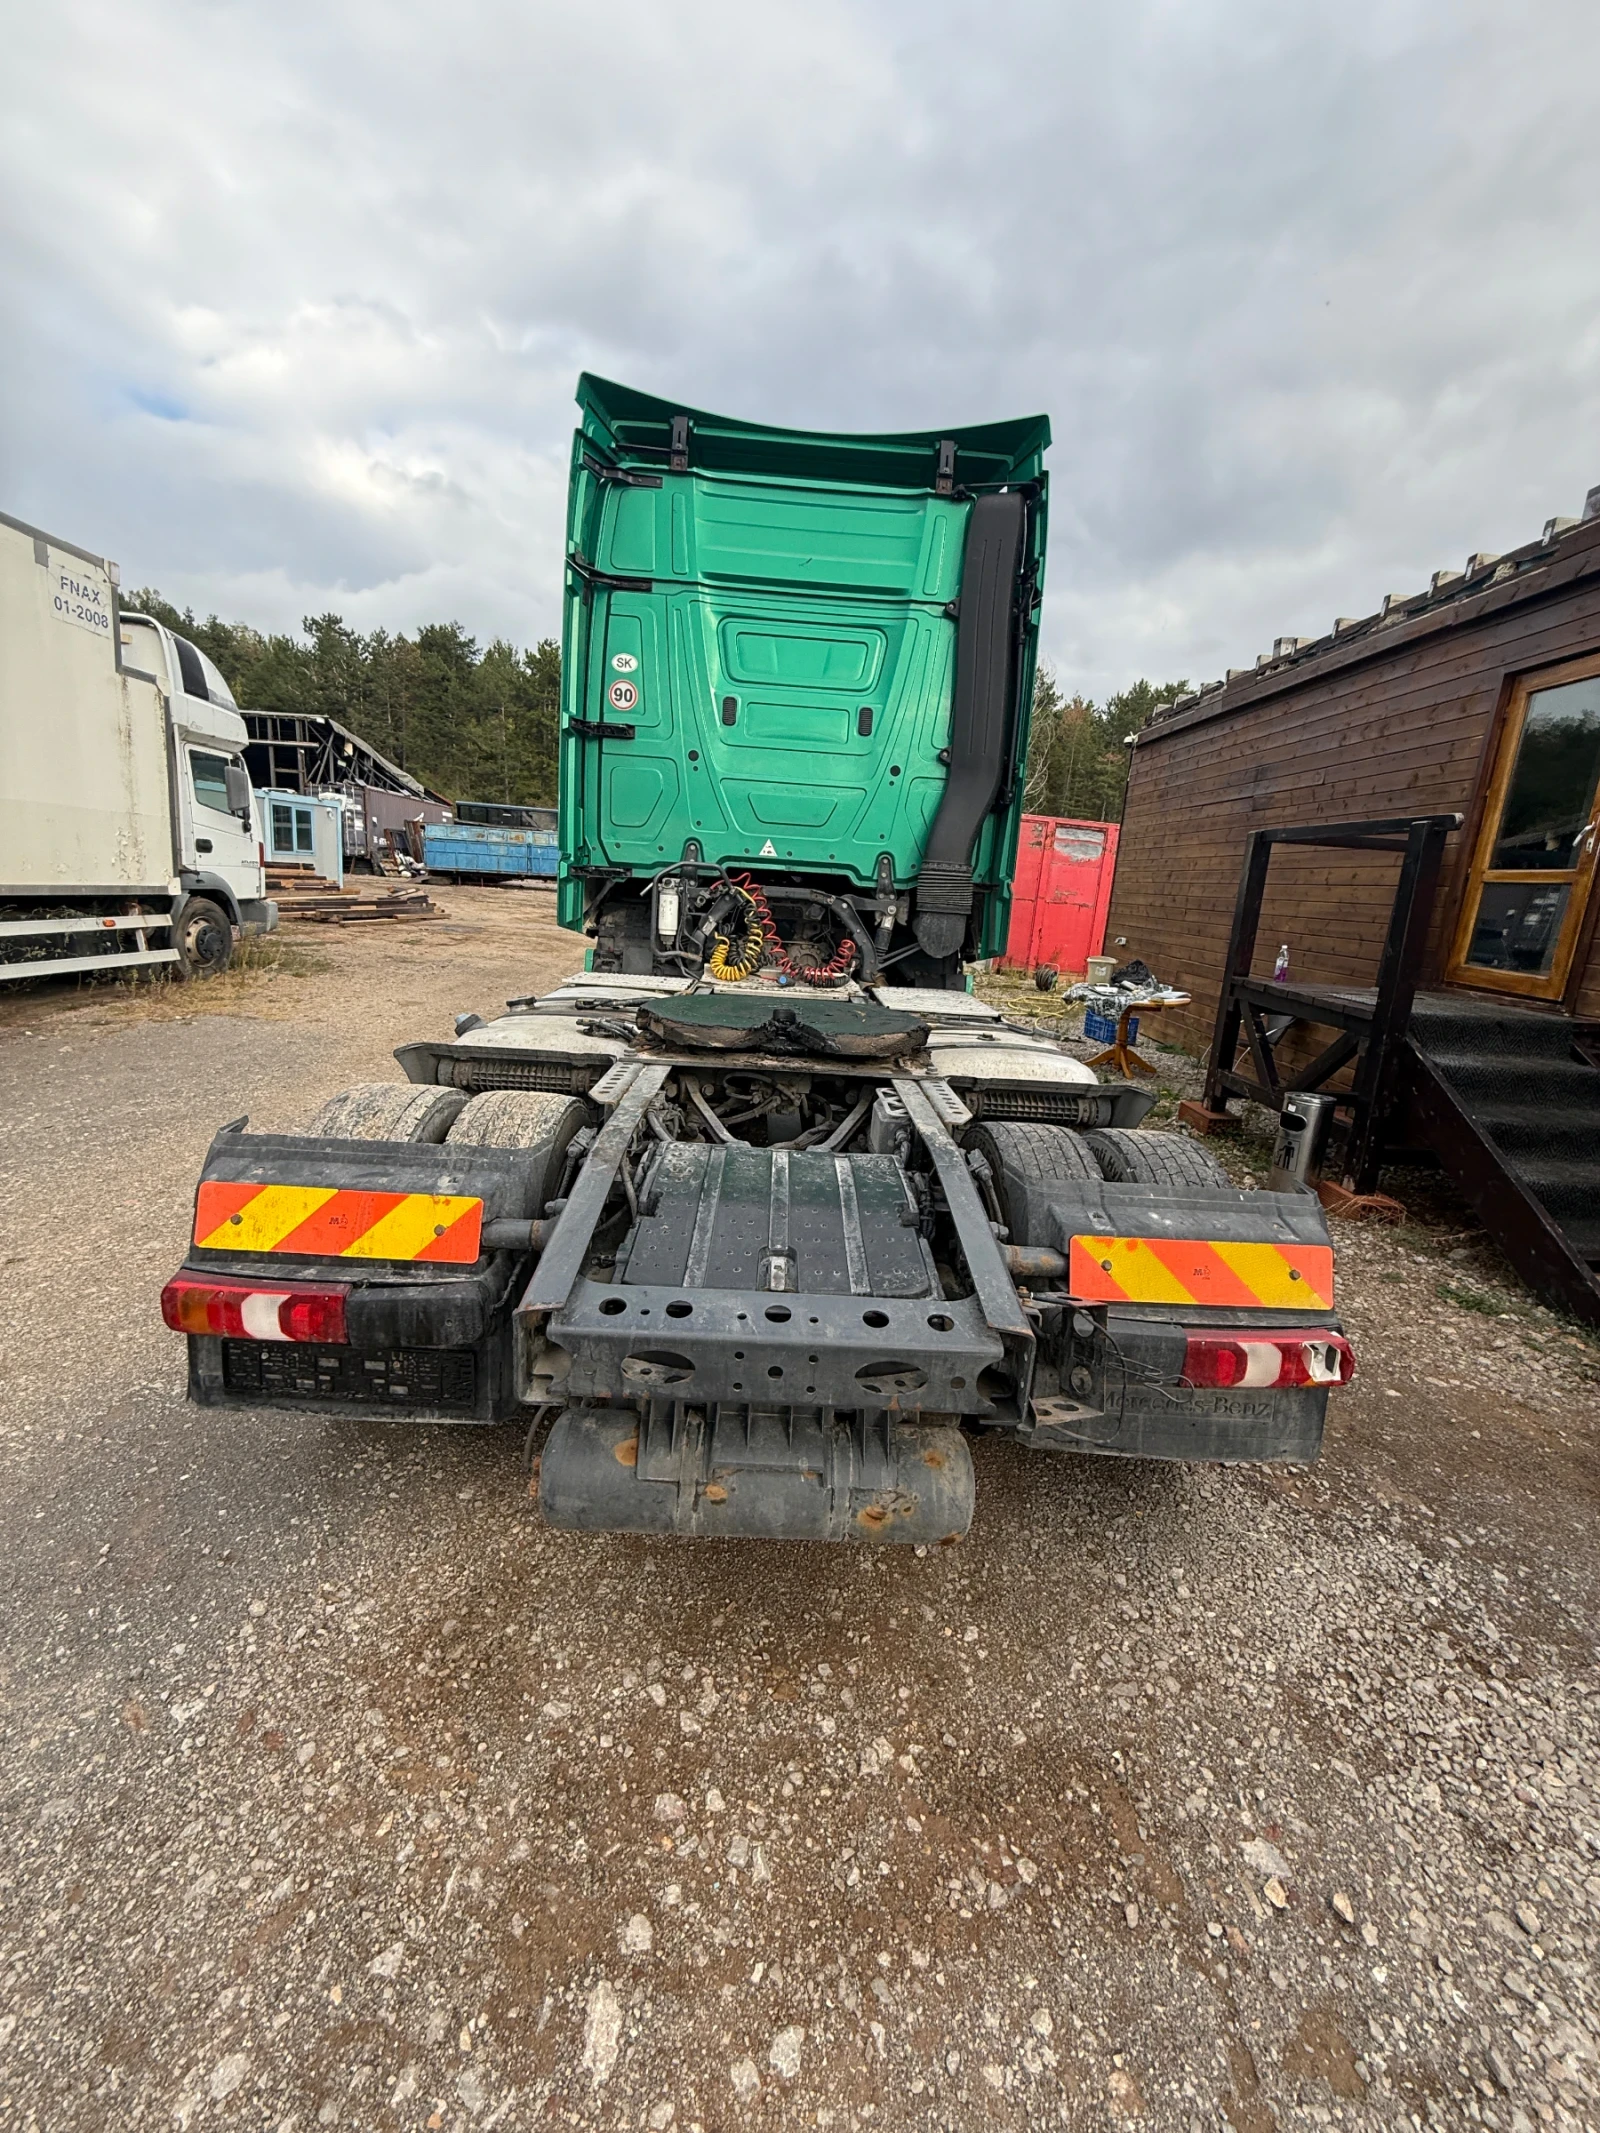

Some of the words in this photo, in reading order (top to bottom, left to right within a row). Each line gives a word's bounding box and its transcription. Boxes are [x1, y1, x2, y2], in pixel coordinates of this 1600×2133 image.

[60, 575, 101, 605] FNAX
[53, 595, 109, 629] 01-2008
[616, 657, 633, 669] SK
[613, 687, 633, 703] 90
